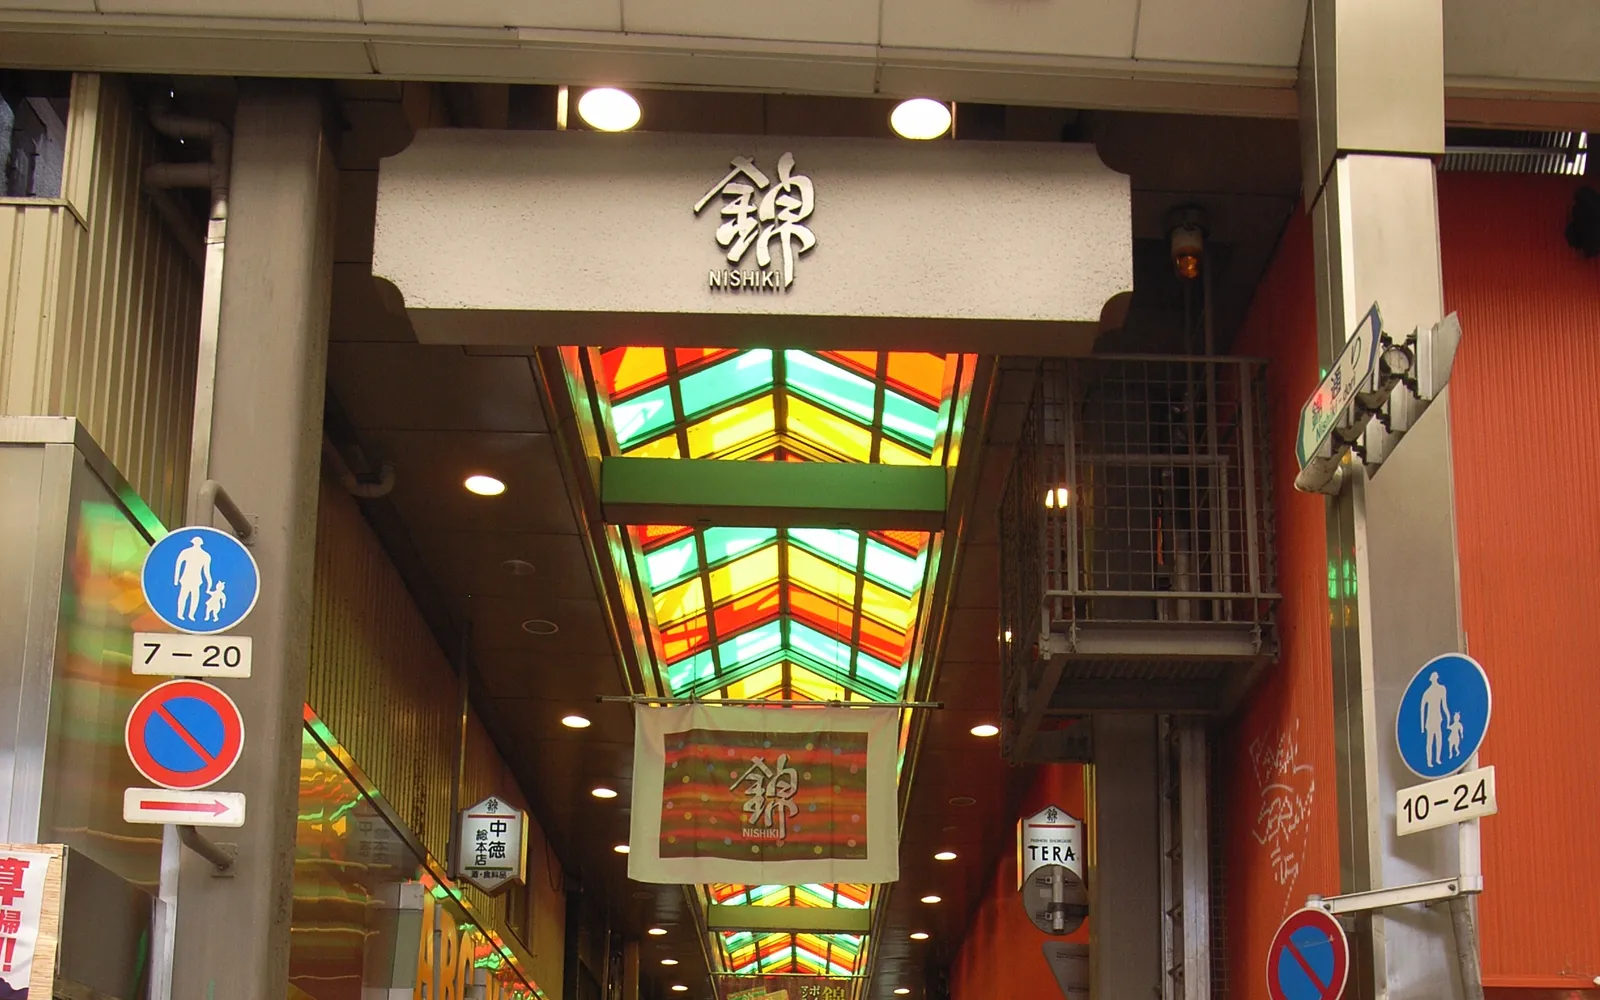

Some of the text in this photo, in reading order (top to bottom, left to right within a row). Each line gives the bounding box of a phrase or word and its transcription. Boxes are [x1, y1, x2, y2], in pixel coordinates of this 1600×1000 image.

[694, 151, 817, 289] 錦
[729, 753, 799, 839] 錦
[1403, 778, 1487, 823] 10-24
[475, 829, 488, 866] 総本店
[488, 819, 507, 859] 中徳
[742, 828, 779, 838] NISHIKI
[1028, 845, 1076, 864] TERA
